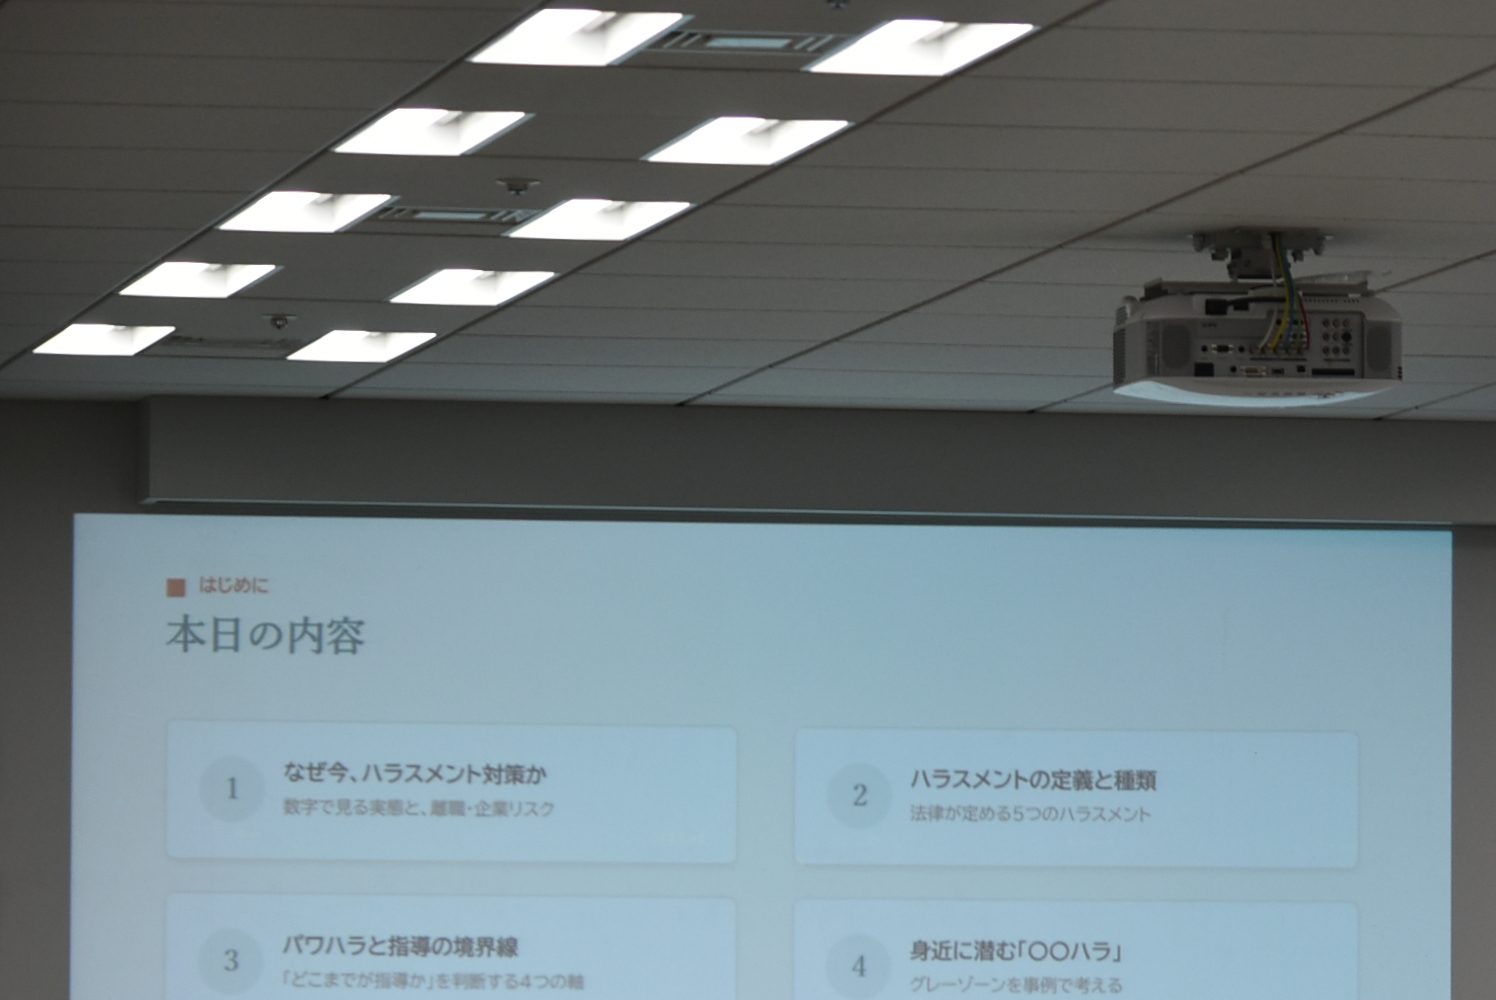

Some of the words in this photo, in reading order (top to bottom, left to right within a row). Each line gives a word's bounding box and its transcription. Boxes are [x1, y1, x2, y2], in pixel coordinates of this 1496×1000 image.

[199, 577, 269, 594] はじめに
[166, 614, 365, 655] 本日の内容
[283, 761, 547, 785] なぜ今、ハラスメント対策か
[910, 768, 1158, 792] ハラスメントの定義と種類
[226, 777, 239, 799] 1
[853, 783, 868, 807] 2
[283, 798, 555, 818] 数字で見る実態と、離職・企業リスク
[909, 803, 1151, 823] 法律が定める5つのハラスメント
[282, 935, 519, 958] パワハラと指導の境界線
[224, 948, 240, 972] 3
[851, 955, 867, 978] 4
[282, 970, 585, 991] 「どこまでが指導か」を判断する4つの軸
[910, 975, 1123, 995] グレーゾーンを事例で考える
